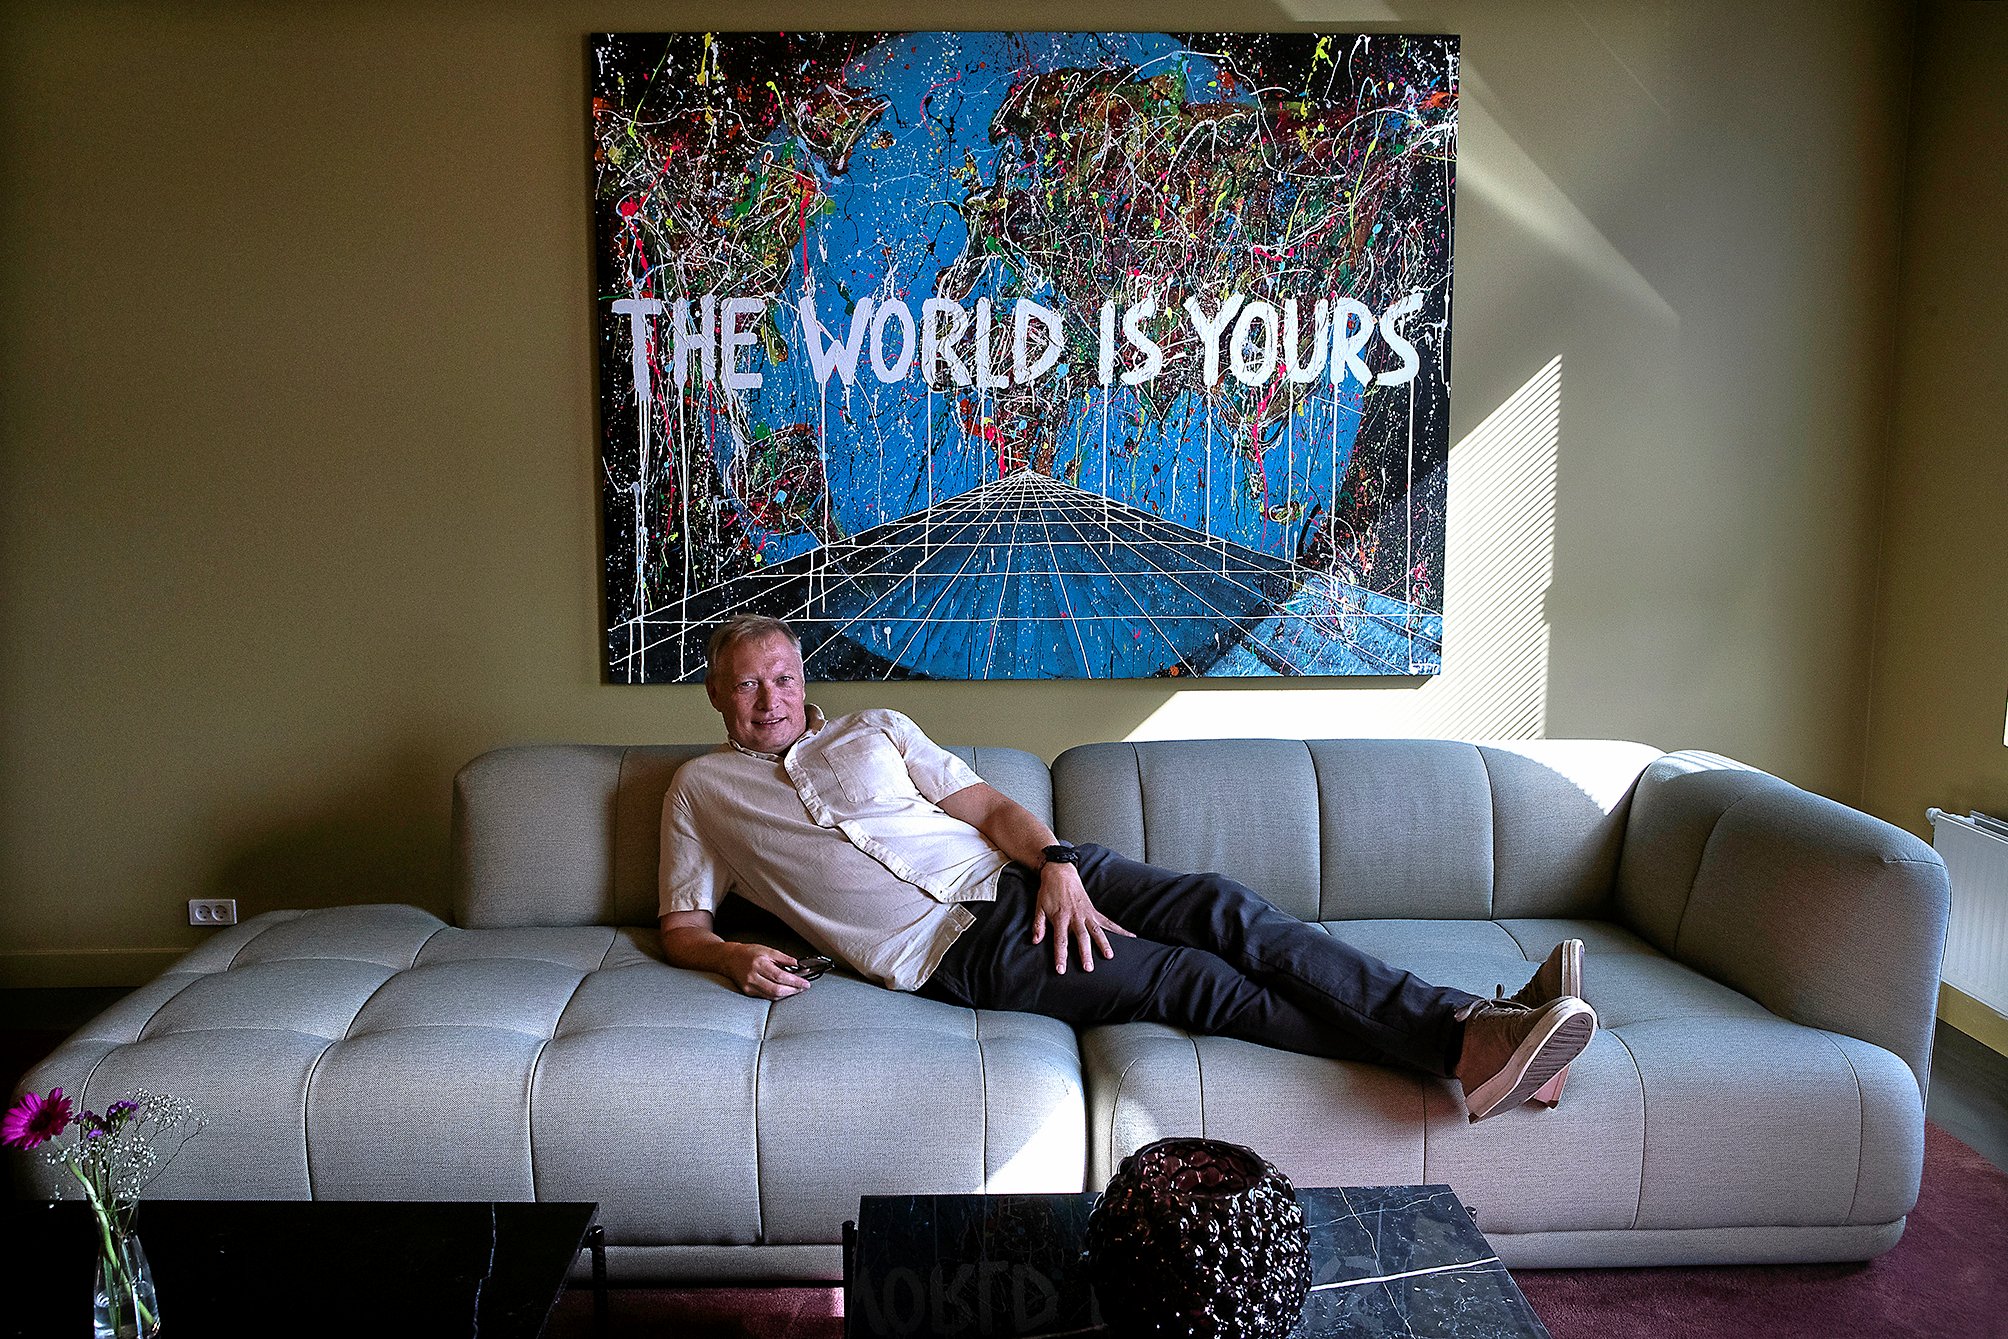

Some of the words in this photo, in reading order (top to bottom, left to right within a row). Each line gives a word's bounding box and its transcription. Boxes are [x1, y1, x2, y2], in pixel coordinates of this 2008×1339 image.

[612, 297, 766, 397] THE
[799, 297, 1064, 391] WORLD
[1099, 294, 1163, 386] IS
[1183, 292, 1424, 388] YOURS
